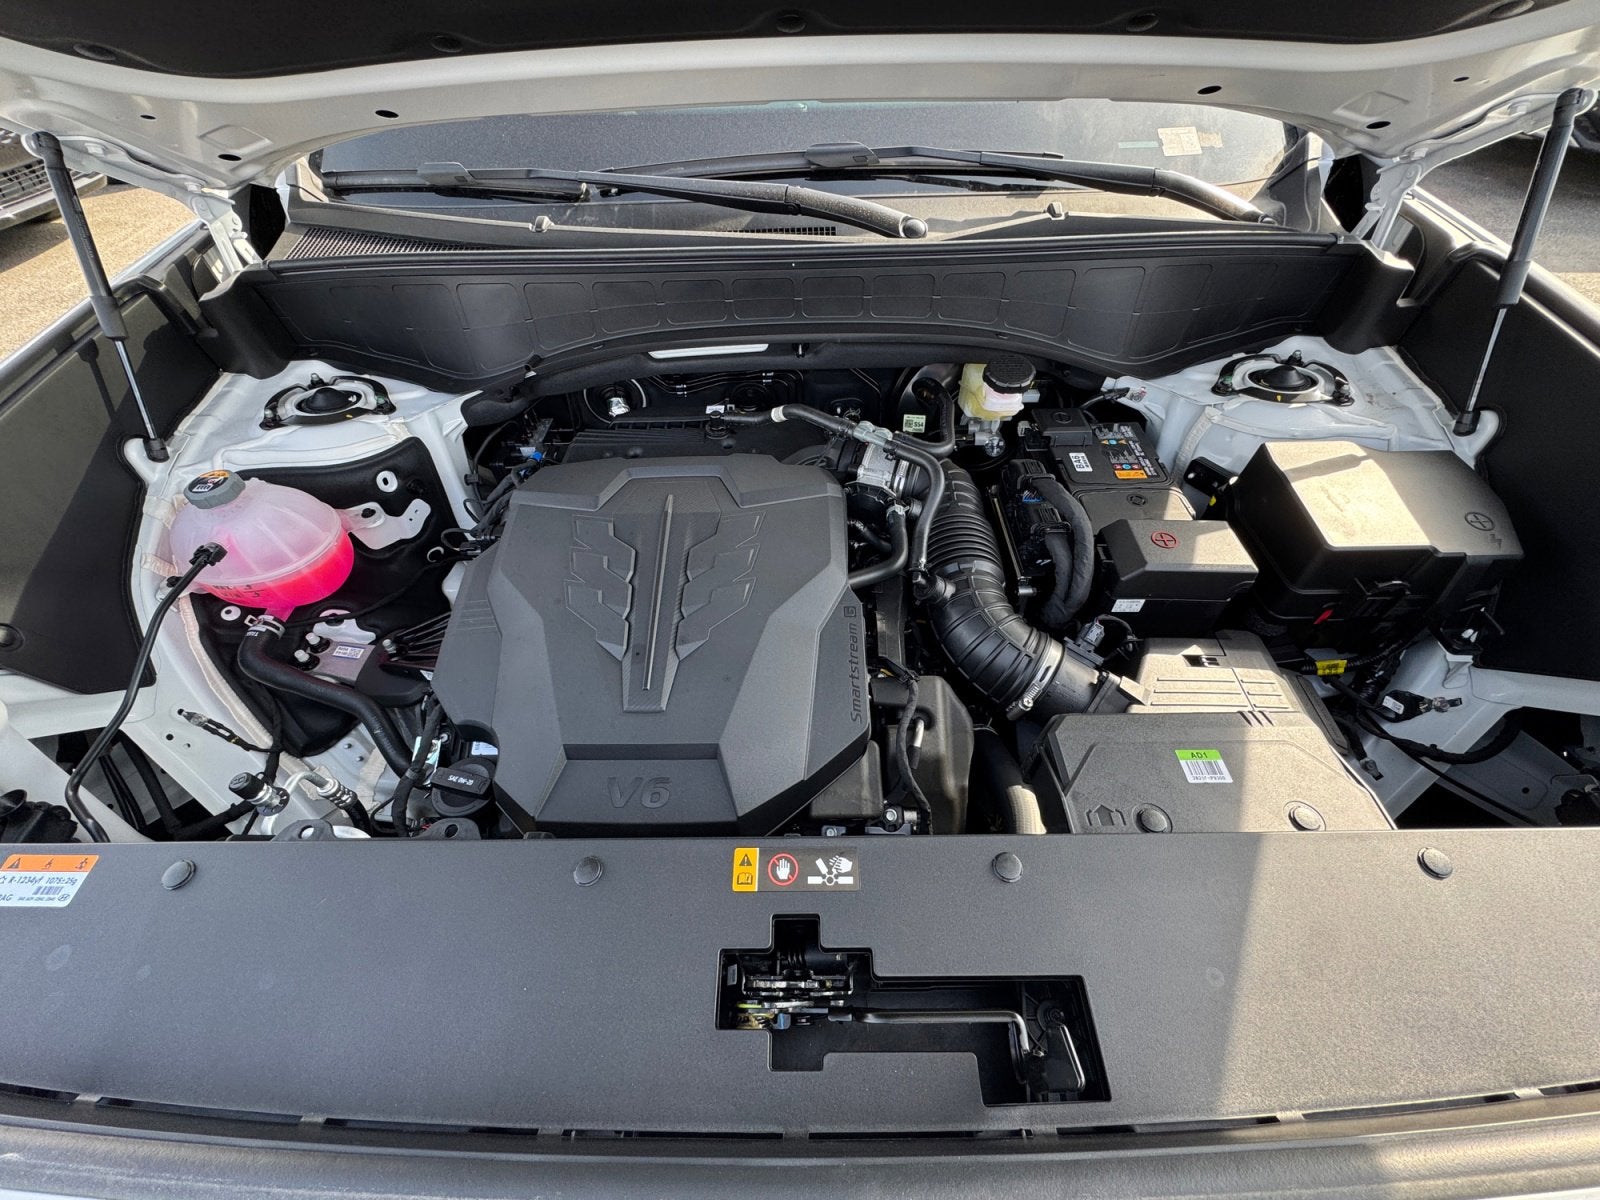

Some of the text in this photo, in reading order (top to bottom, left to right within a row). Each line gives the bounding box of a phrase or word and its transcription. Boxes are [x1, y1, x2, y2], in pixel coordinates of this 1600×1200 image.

[1071, 455, 1085, 469] BA6
[847, 622, 863, 724] Smartstream
[448, 774, 458, 783] SAE
[607, 776, 672, 809] V6
[7, 876, 44, 886] R-1234yf
